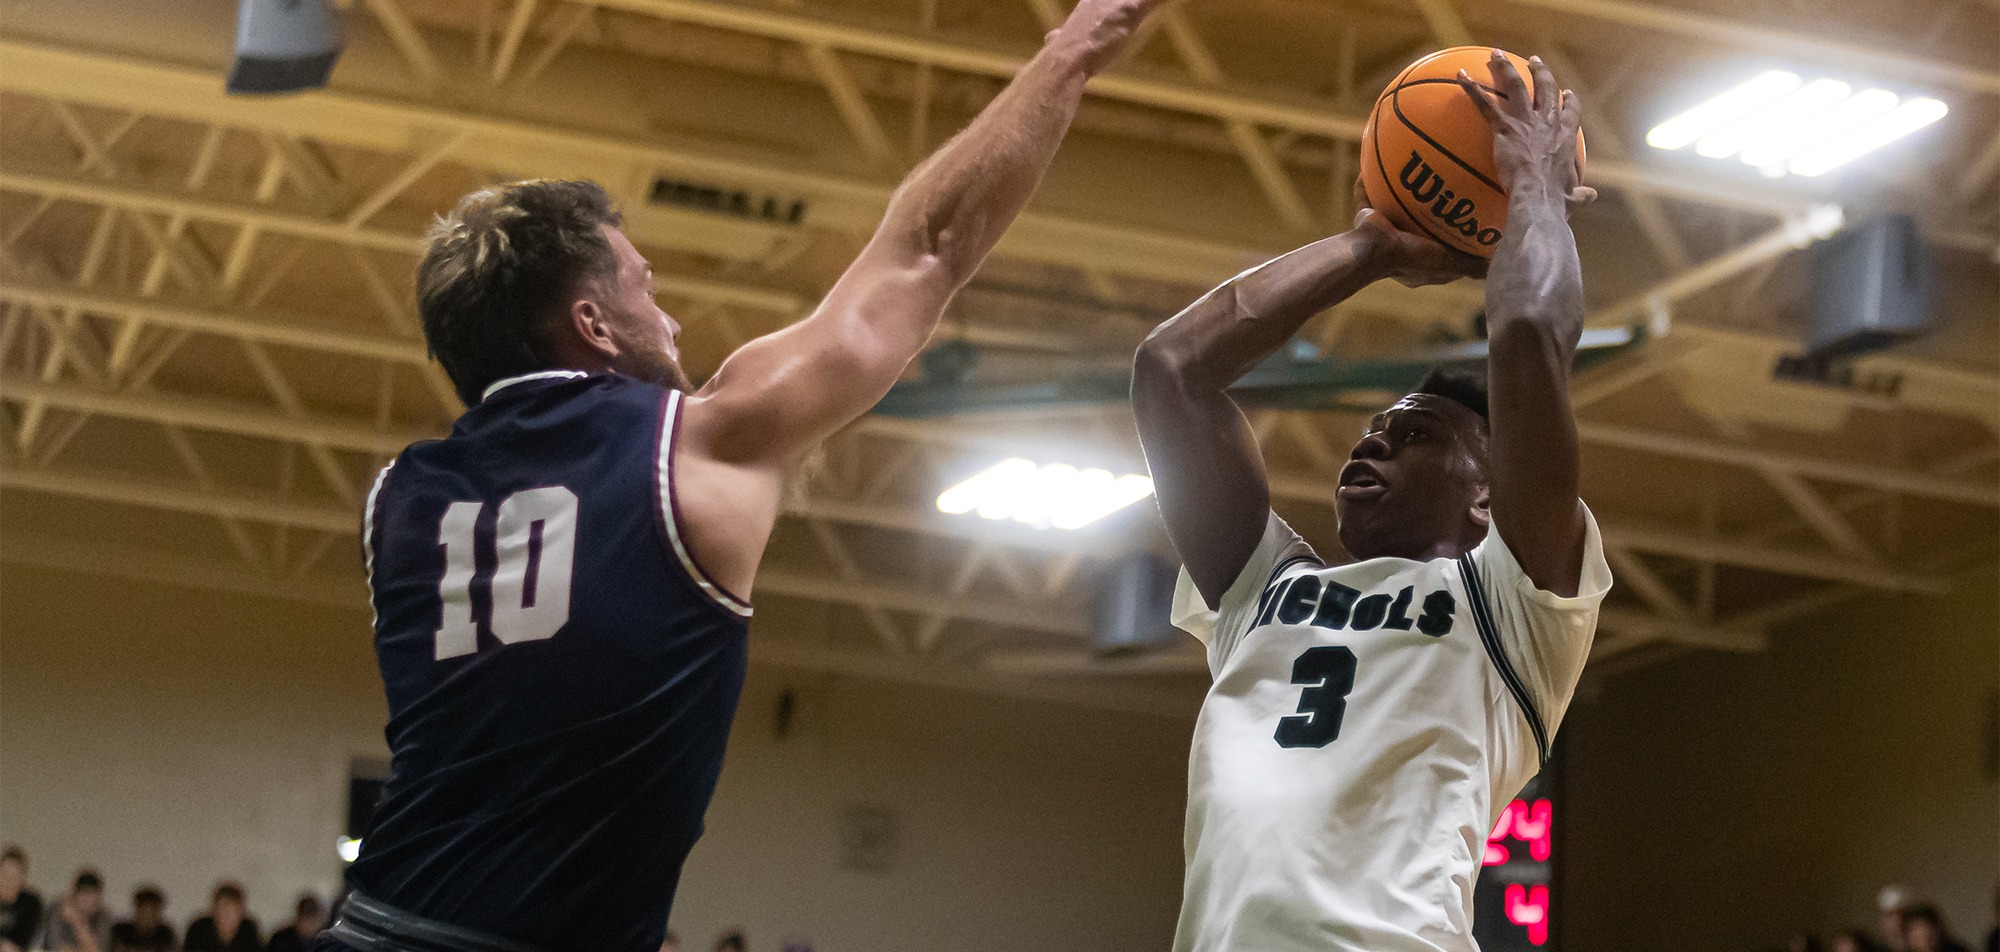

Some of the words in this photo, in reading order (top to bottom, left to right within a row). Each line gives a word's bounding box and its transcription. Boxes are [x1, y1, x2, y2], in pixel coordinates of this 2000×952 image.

[1400, 150, 1503, 246] Wilso
[434, 485, 579, 661] 10
[1273, 645, 1358, 749] 3
[1504, 883, 1550, 947] 4
